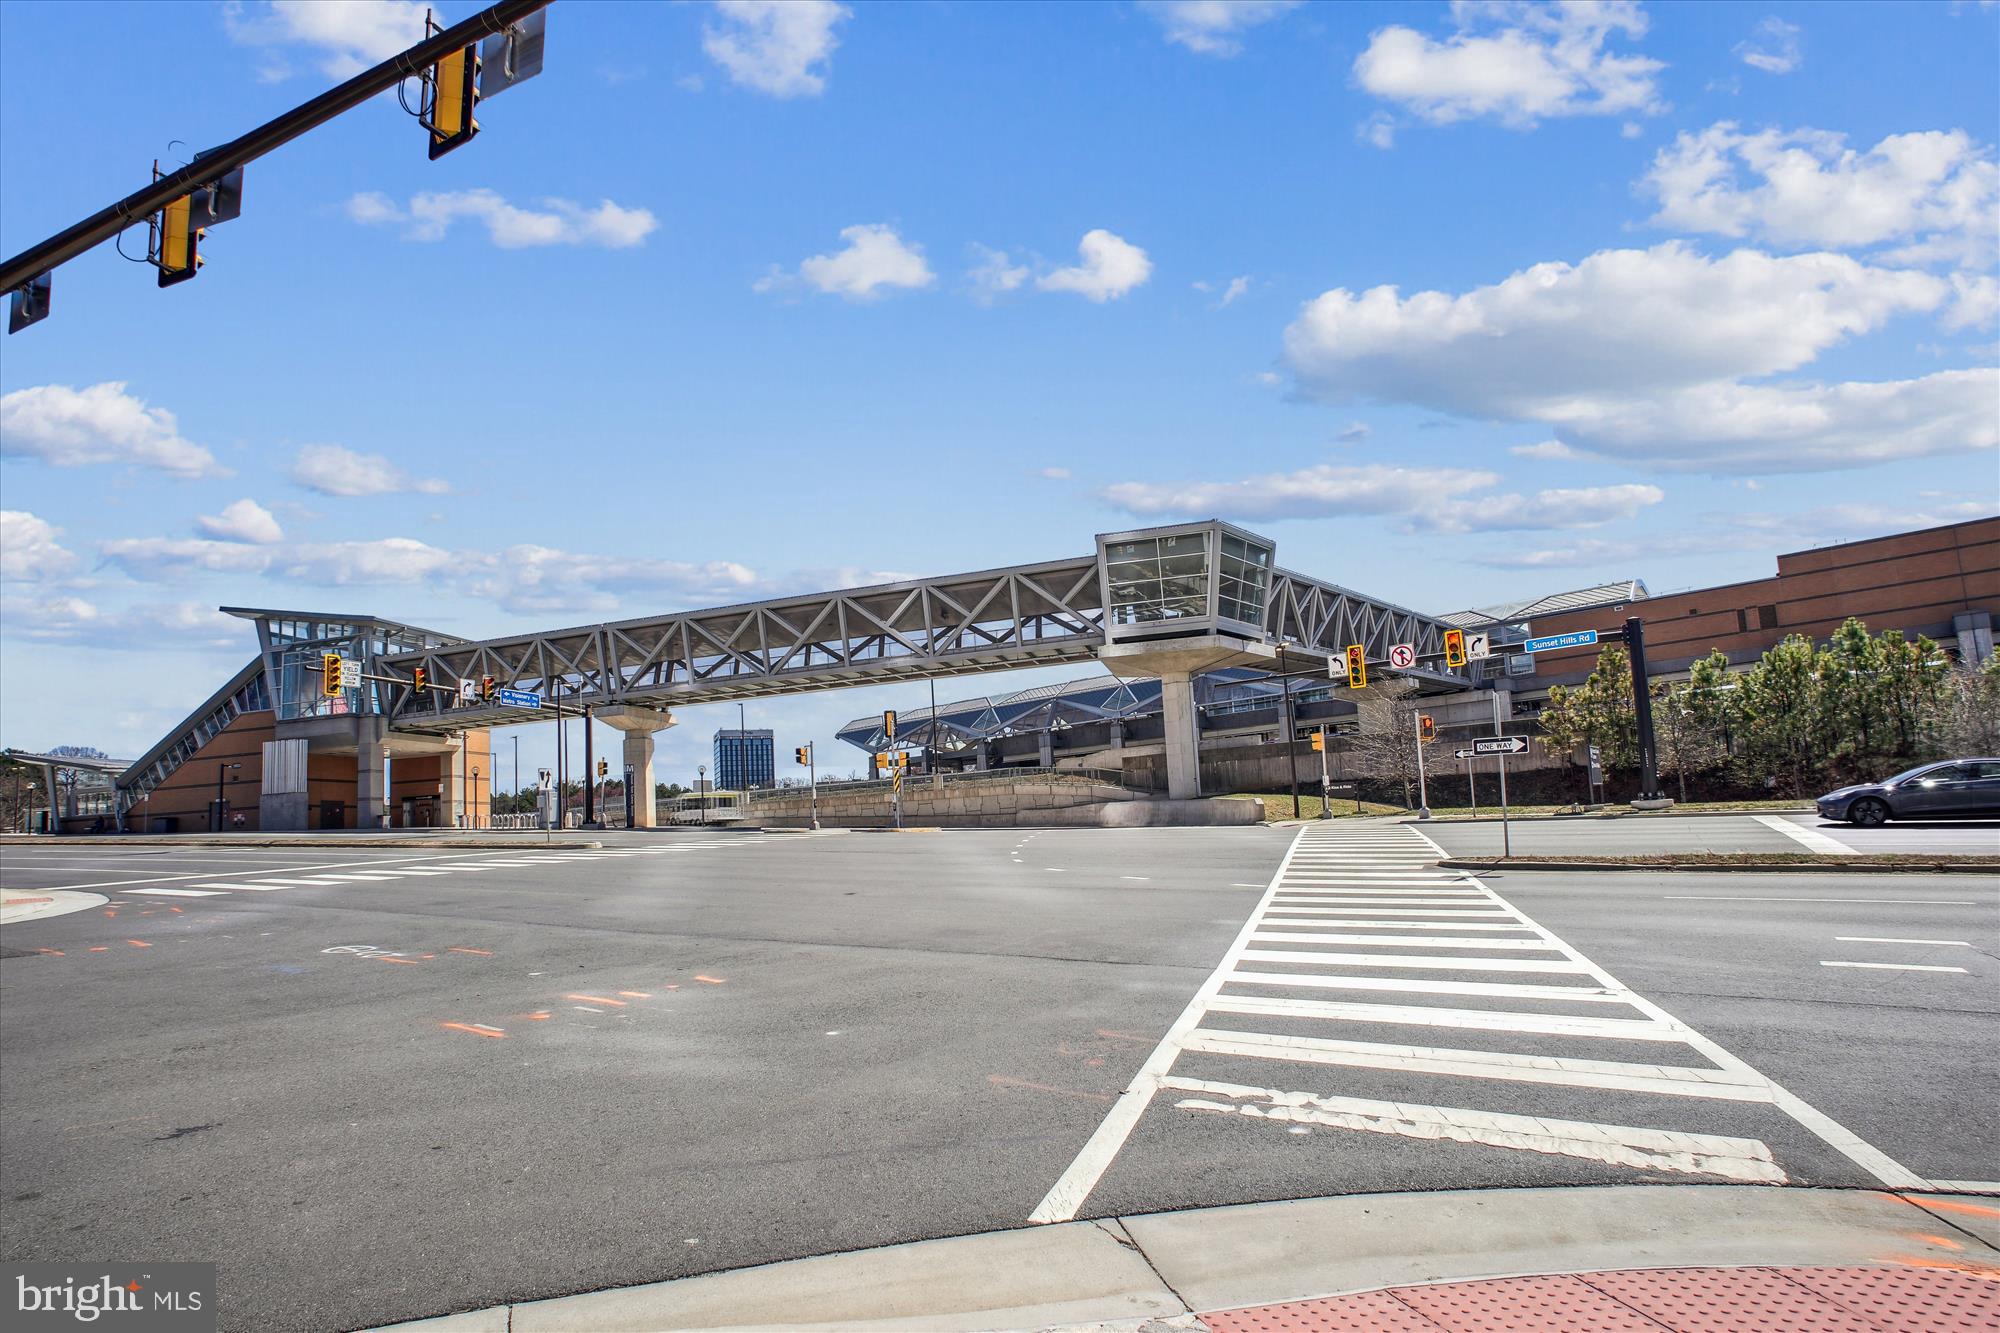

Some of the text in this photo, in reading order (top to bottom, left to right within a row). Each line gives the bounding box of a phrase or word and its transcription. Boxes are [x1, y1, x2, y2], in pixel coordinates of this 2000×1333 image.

[1532, 634, 1590, 650] Sunset Hills Rd
